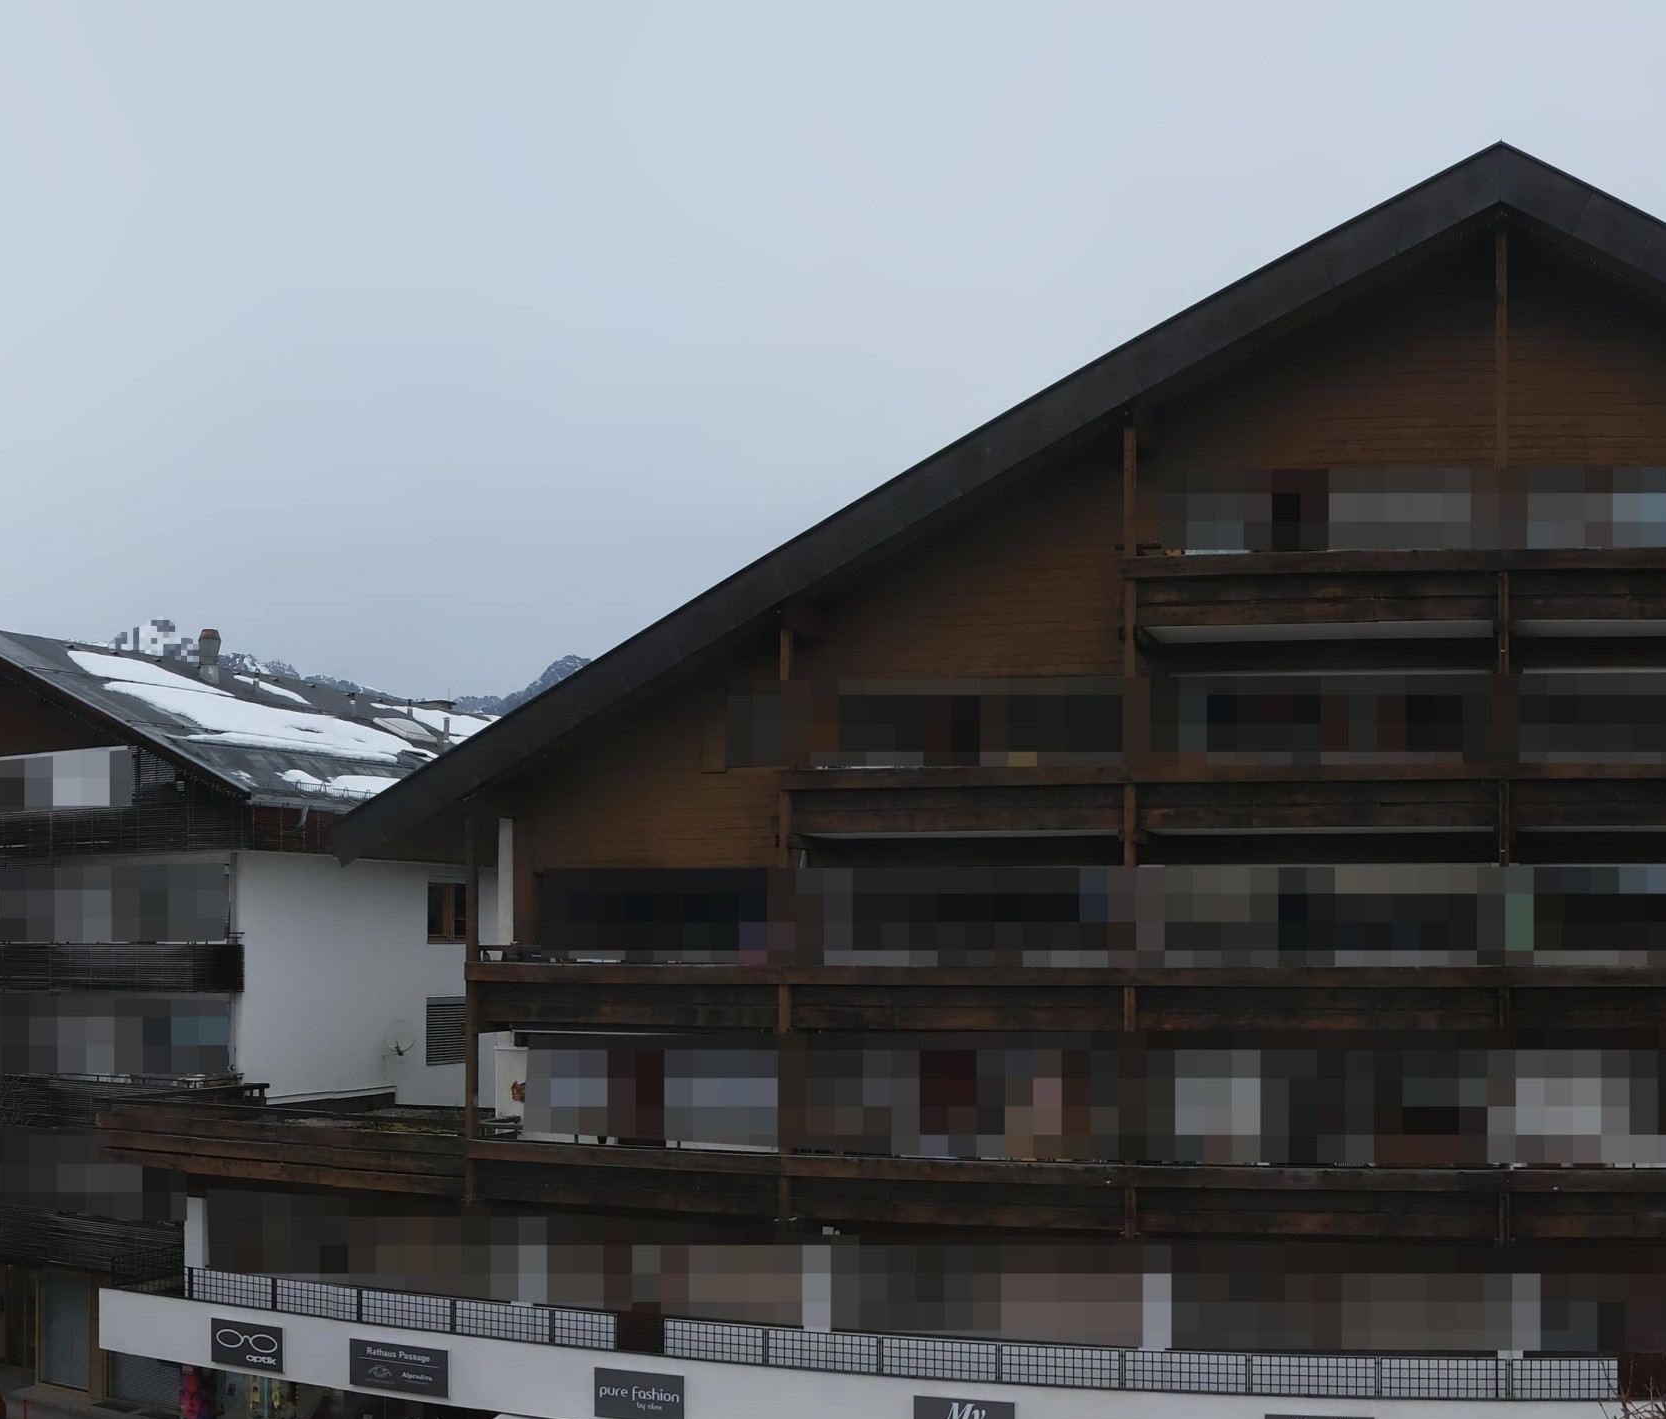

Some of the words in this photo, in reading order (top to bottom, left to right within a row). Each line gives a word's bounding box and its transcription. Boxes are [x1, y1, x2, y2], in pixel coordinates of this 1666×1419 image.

[245, 1354, 277, 1366] optik
[366, 1347, 396, 1358] Rathaus
[399, 1351, 430, 1363] Passage
[599, 1386, 628, 1398] pure
[632, 1386, 680, 1403] fashion
[636, 1401, 646, 1410] by
